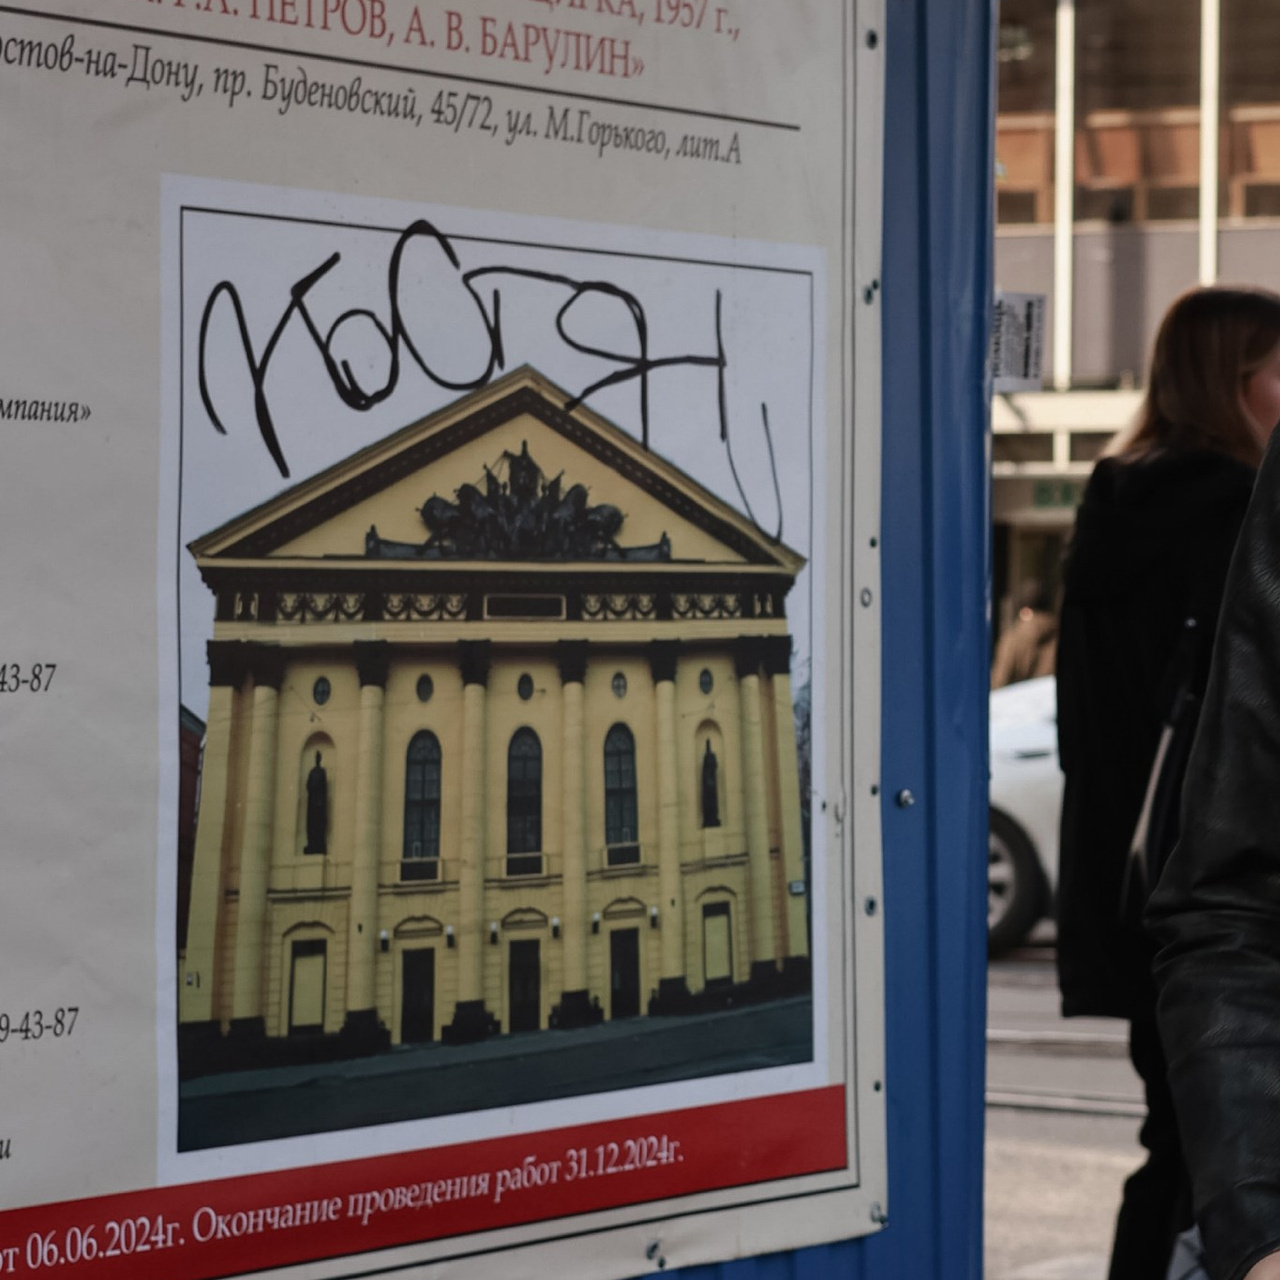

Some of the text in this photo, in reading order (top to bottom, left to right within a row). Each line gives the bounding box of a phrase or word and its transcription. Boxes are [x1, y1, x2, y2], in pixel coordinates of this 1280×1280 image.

[403, 5, 435, 48] А.
[445, 10, 470, 53] В.
[480, 16, 645, 79] БАРУЛИН»
[715, 7, 740, 41] г.,
[0, 33, 743, 165] стов-на-Дону, пр. Буденовский, 45/72, ул. М.Горького, лит.А
[0, 1134, 685, 1273] т 06.06.2024г. Окончание проведения работ 31.12.2024г.
